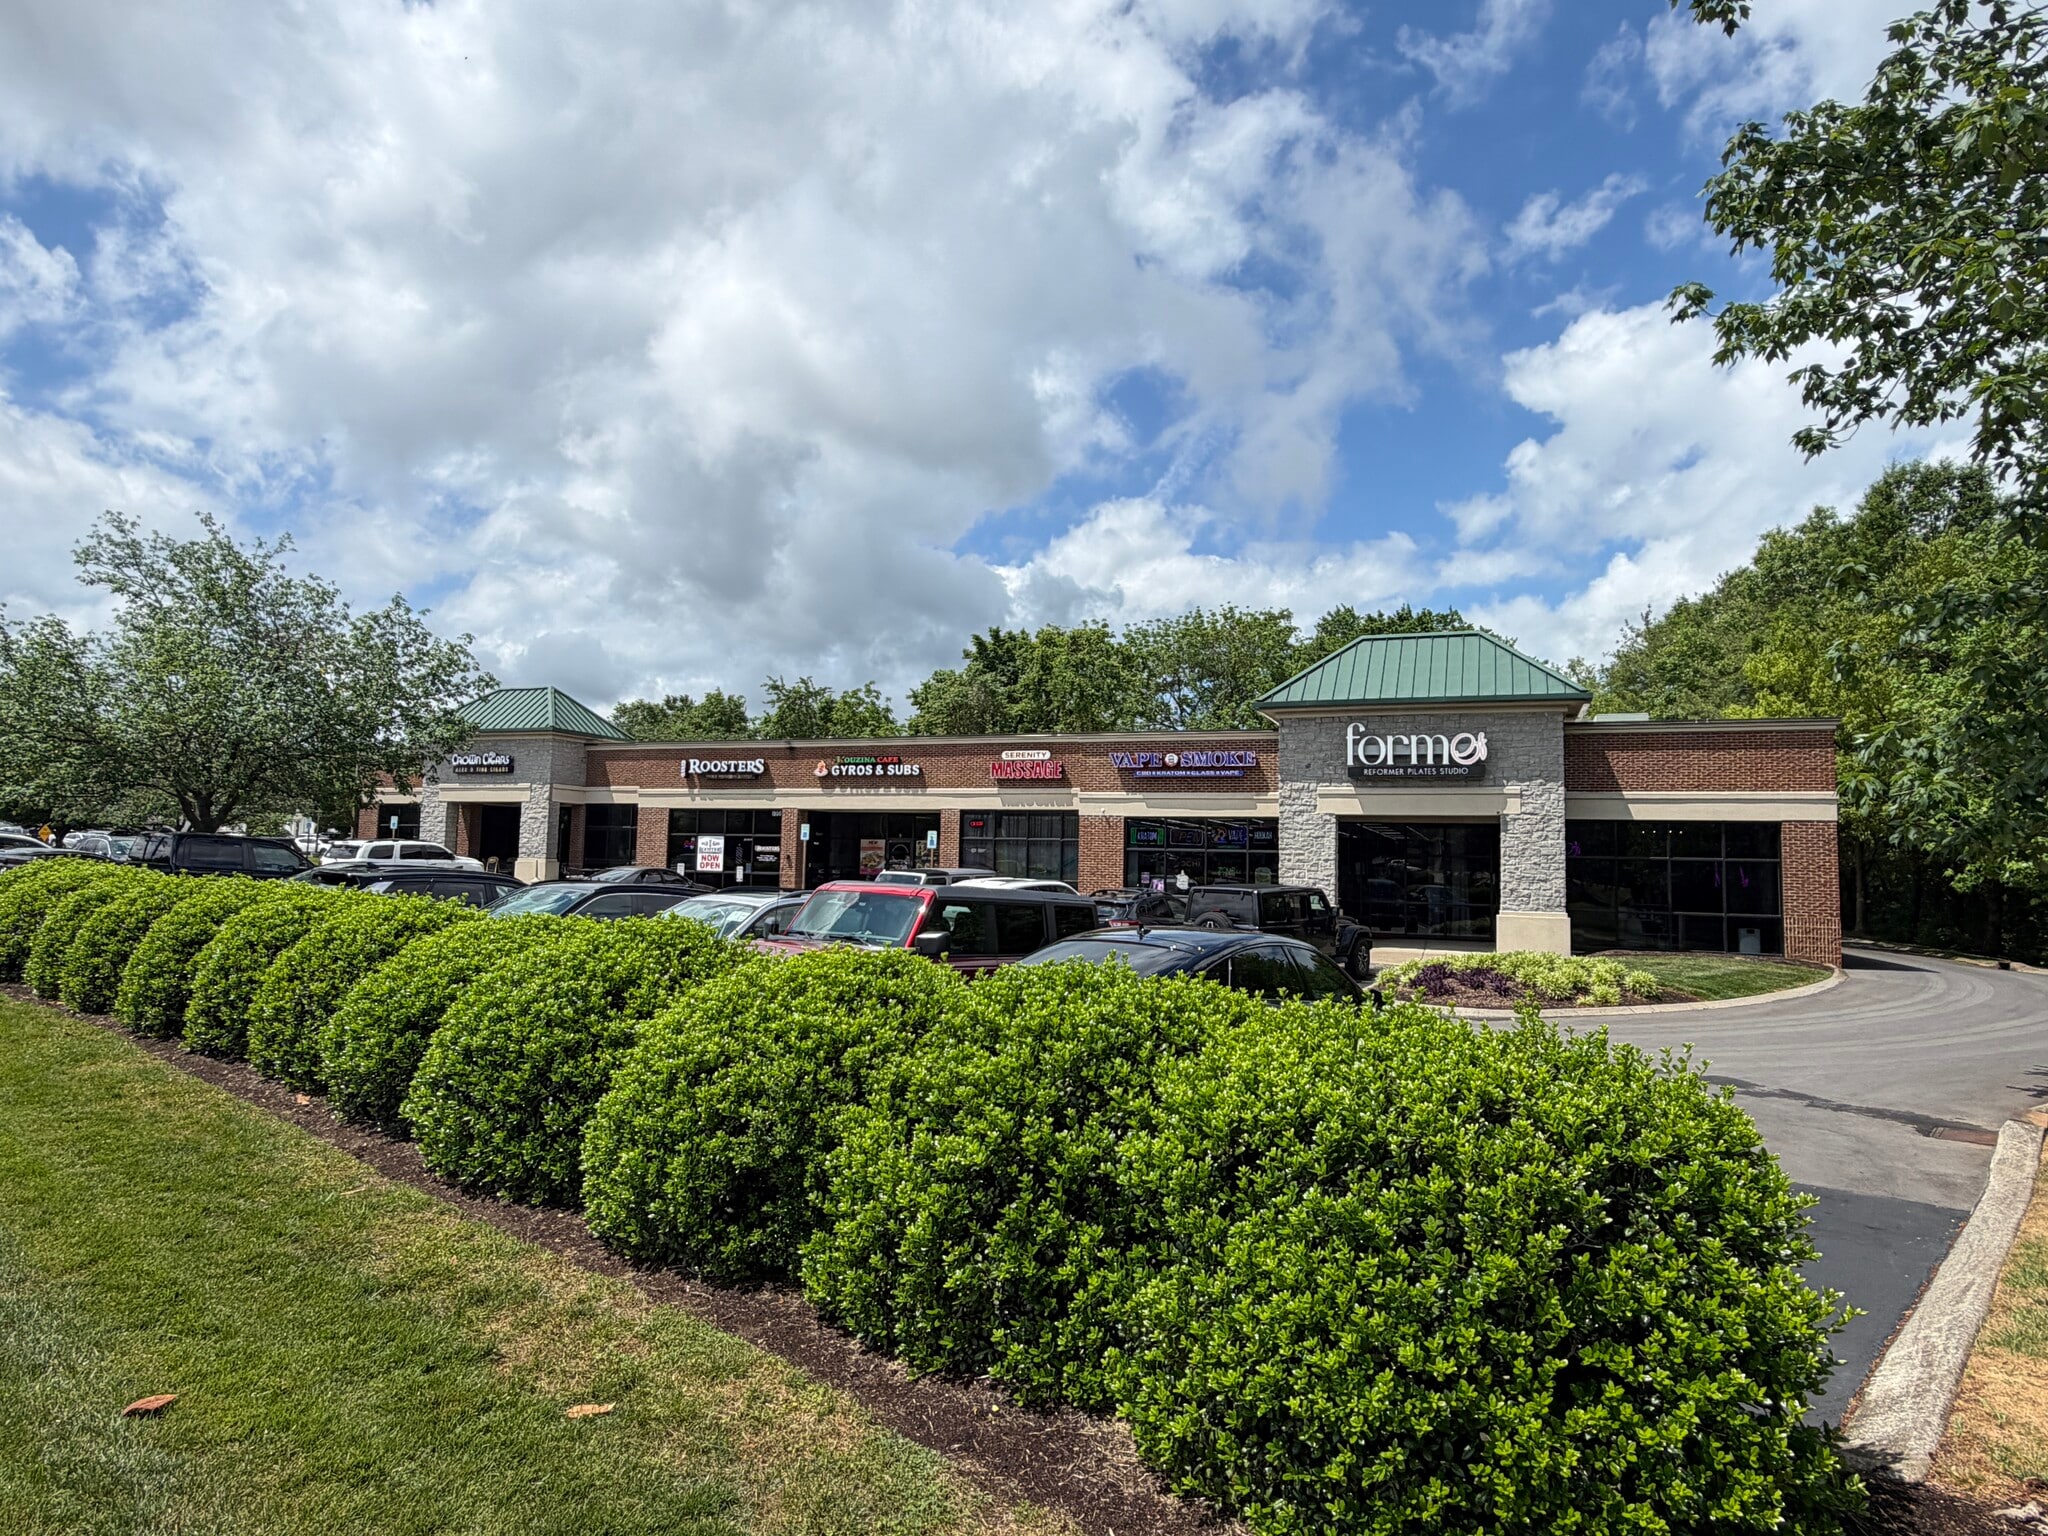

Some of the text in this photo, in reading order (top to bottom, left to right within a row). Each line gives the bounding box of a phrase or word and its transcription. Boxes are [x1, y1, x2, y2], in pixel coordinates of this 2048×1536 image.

[1004, 751, 1047, 759] SERENITY
[1109, 751, 1256, 767] VAPE SMOKE
[877, 756, 899, 764] CAFE
[831, 764, 920, 776] GYROS & SUBS
[991, 760, 1063, 779] MASSAGE
[1363, 767, 1469, 776] REFORMER PILATES STUDIO
[701, 854, 720, 862] NOW
